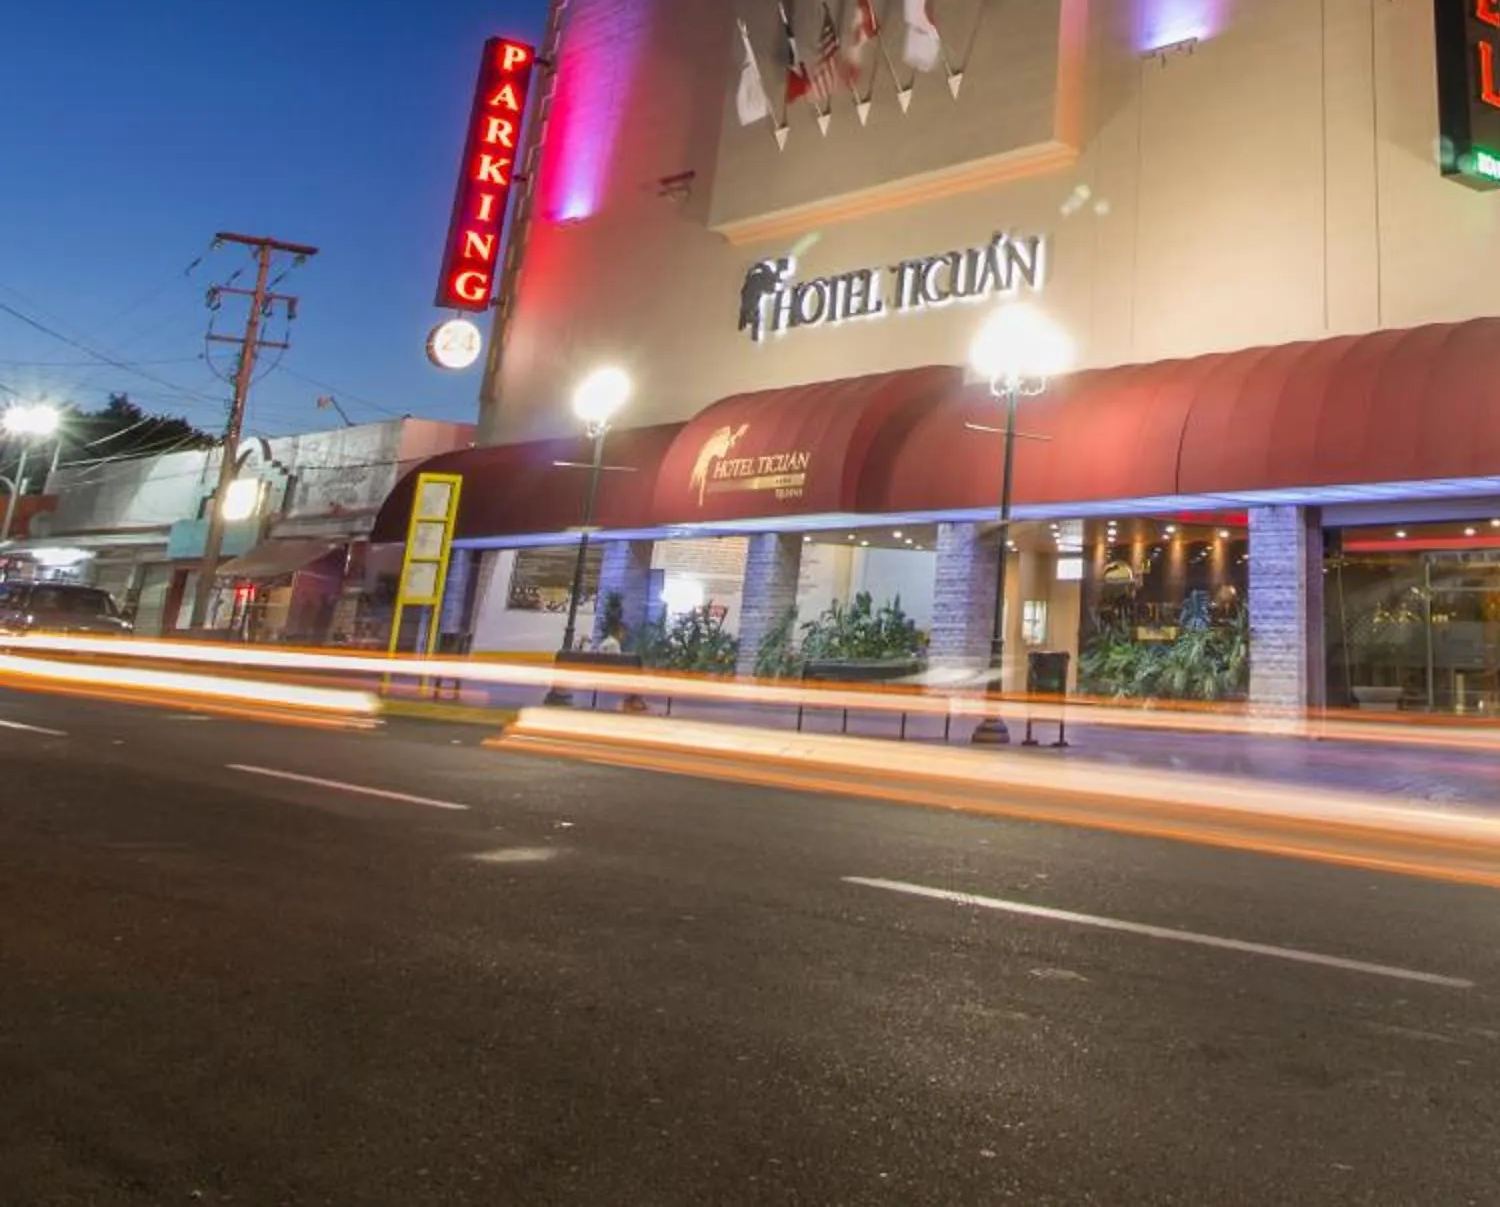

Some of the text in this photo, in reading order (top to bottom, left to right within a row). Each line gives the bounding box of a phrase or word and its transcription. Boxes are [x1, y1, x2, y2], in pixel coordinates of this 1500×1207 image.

[453, 44, 527, 303] PARKING
[771, 230, 1042, 332] HOTEL TICUÁN
[713, 457, 755, 479] HOTEL
